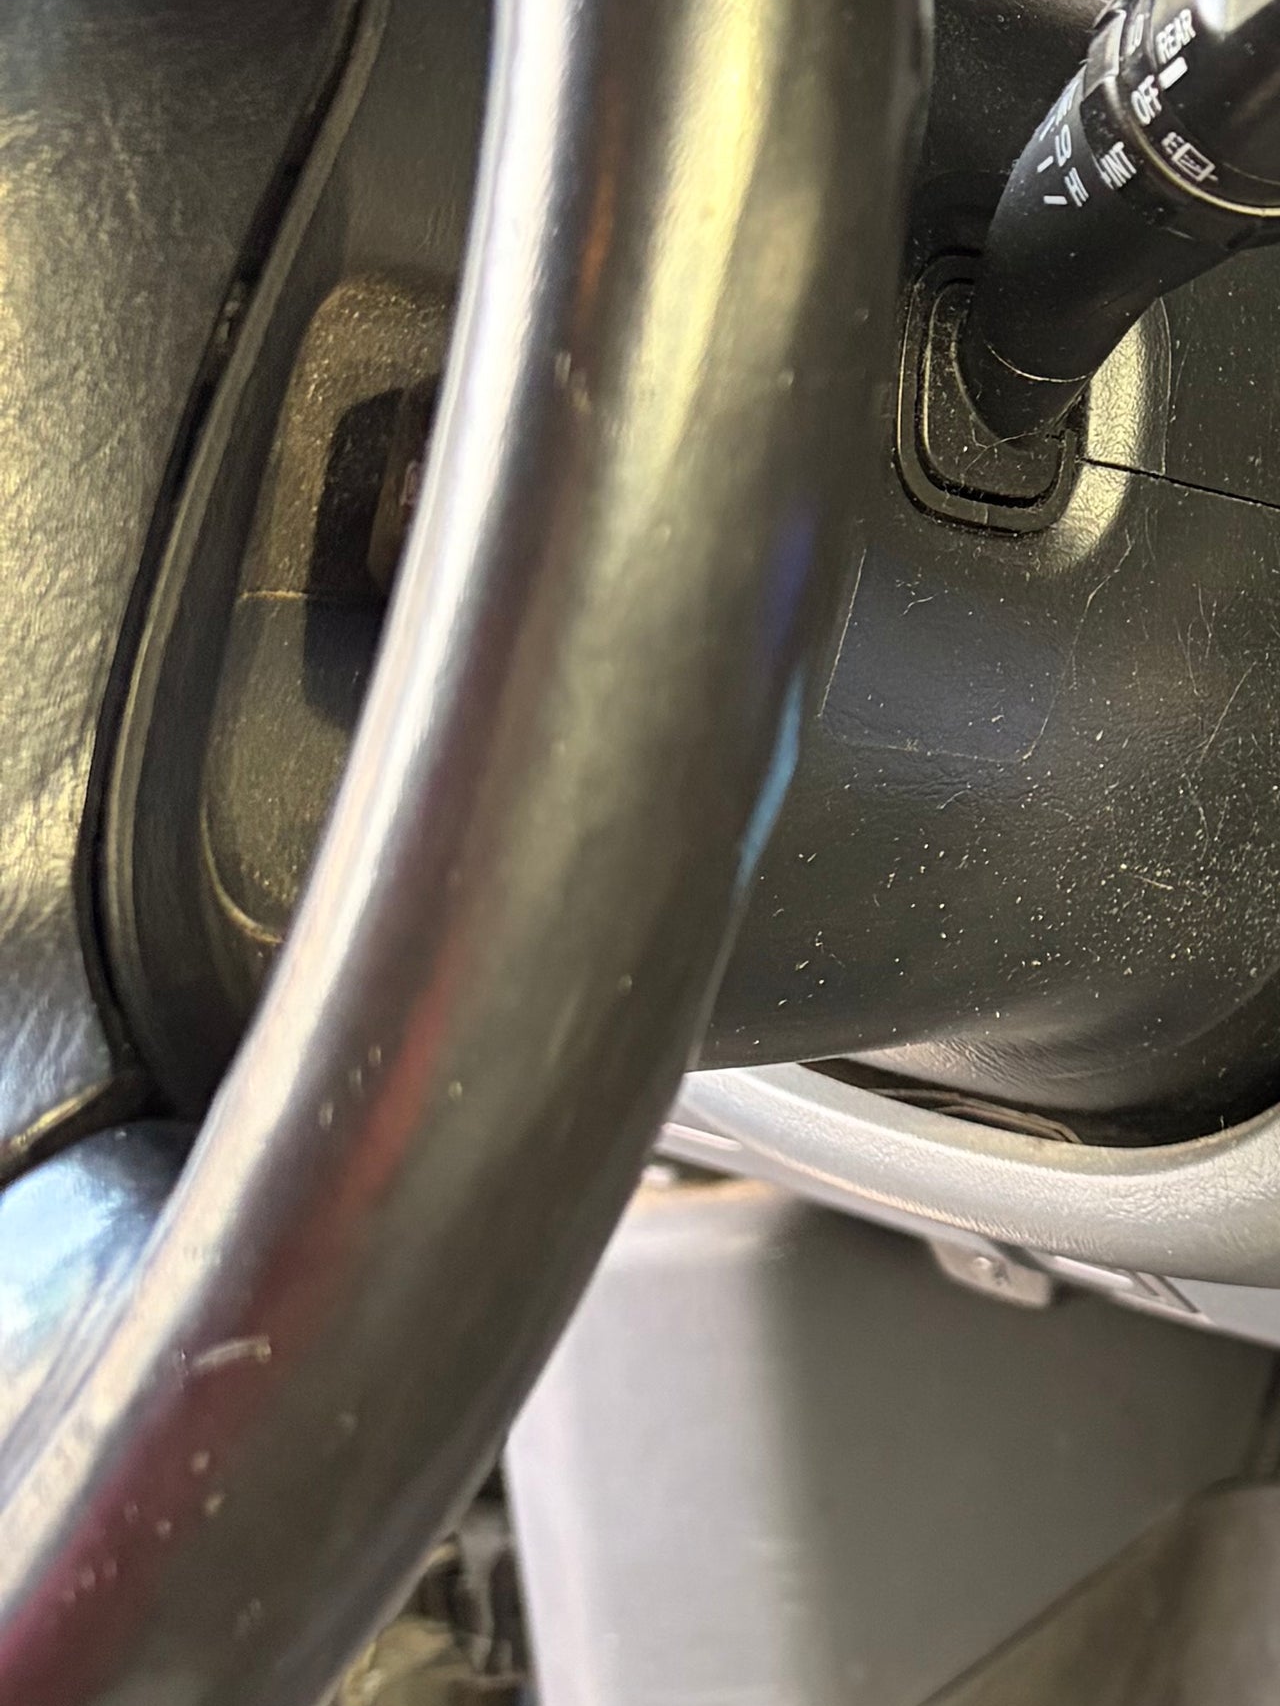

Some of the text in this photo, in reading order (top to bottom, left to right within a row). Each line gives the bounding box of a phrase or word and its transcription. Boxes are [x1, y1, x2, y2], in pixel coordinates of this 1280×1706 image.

[1156, 8, 1196, 64] REAR
[1130, 75, 1162, 125] OFF
[1055, 124, 1072, 167] LO
[1100, 141, 1137, 188] INT
[1064, 167, 1090, 207] HI
